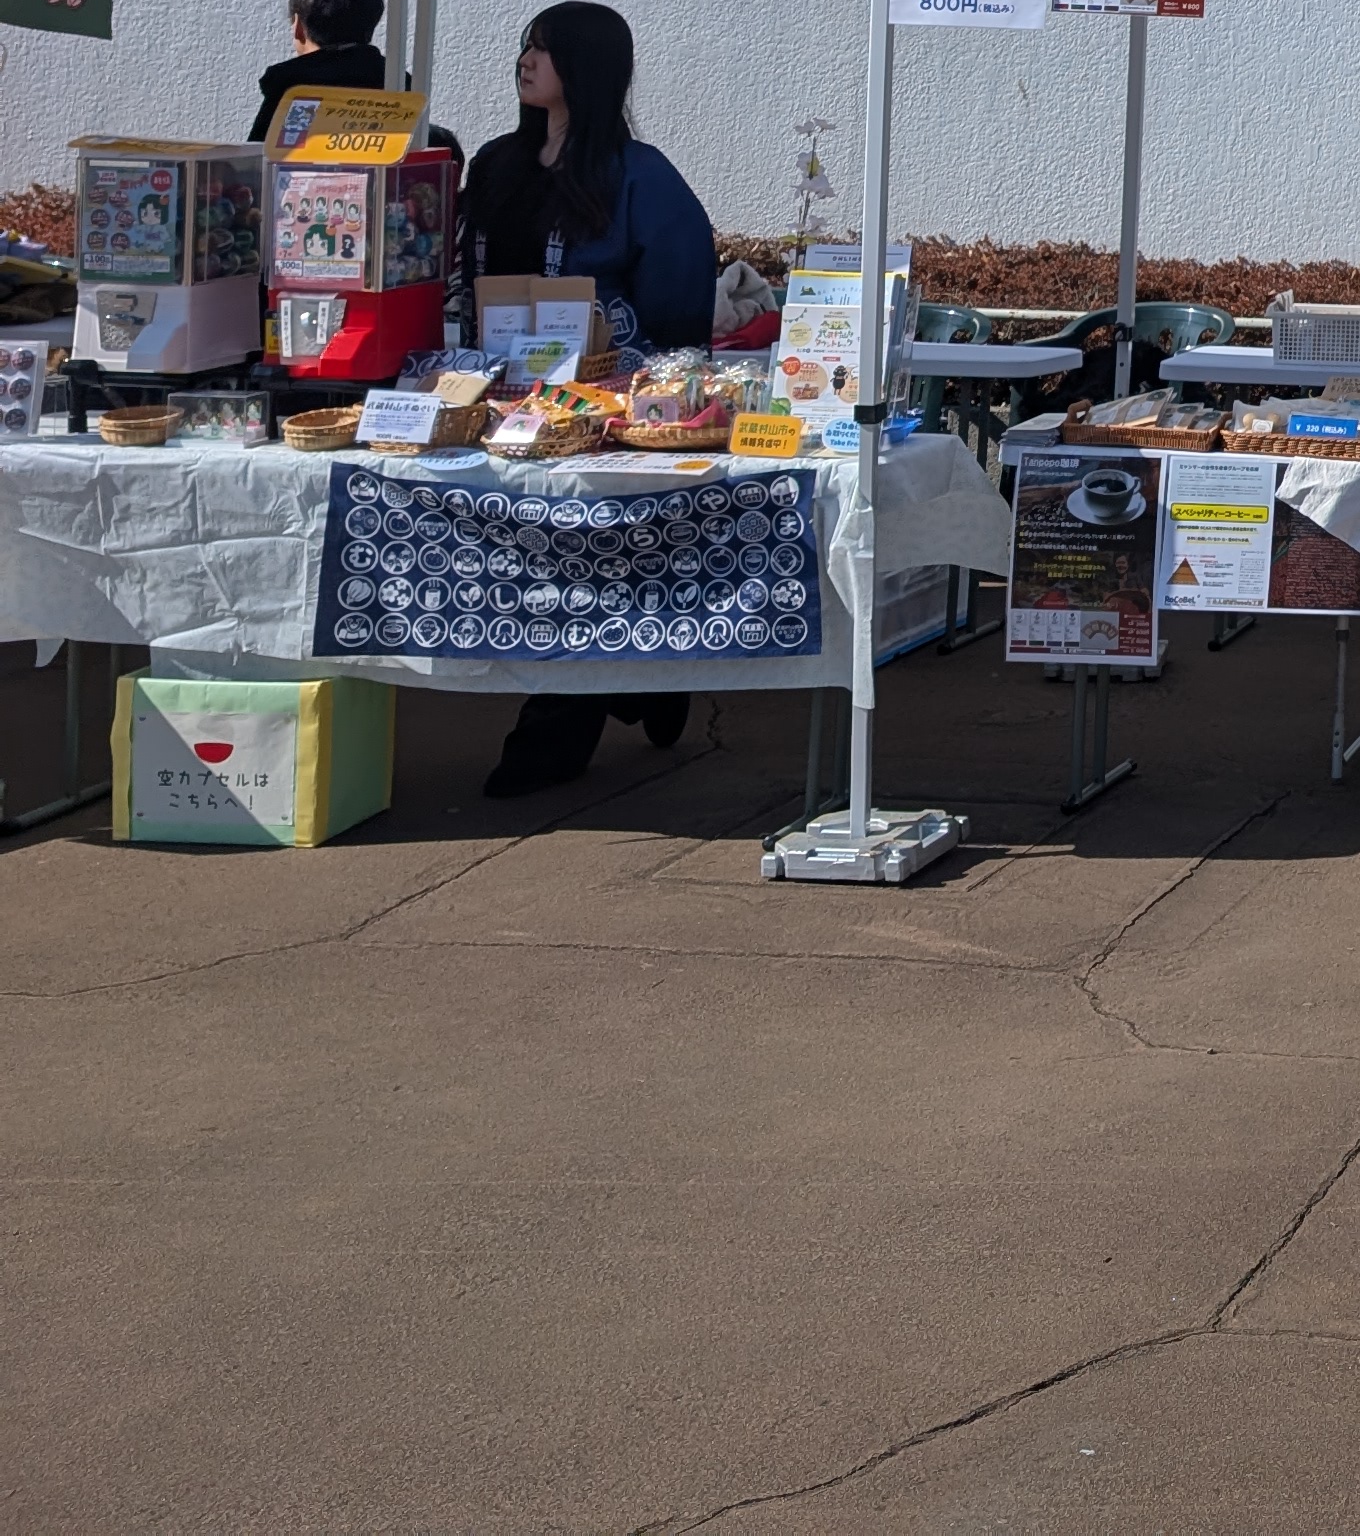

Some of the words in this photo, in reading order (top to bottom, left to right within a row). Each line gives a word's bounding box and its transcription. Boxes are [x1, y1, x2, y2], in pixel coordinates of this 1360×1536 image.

[325, 107, 415, 121] アクリルスタンド
[325, 132, 386, 153] 300円
[738, 421, 796, 437] 武蔵村山市の
[1306, 424, 1319, 433] 220
[846, 439, 859, 447] Fre
[701, 491, 725, 511] や
[778, 514, 798, 536] ま
[633, 528, 655, 547] ら
[349, 545, 373, 568] む
[568, 623, 591, 646] む
[157, 769, 269, 788] 空カプセルは
[169, 793, 254, 811] こちらへ!
